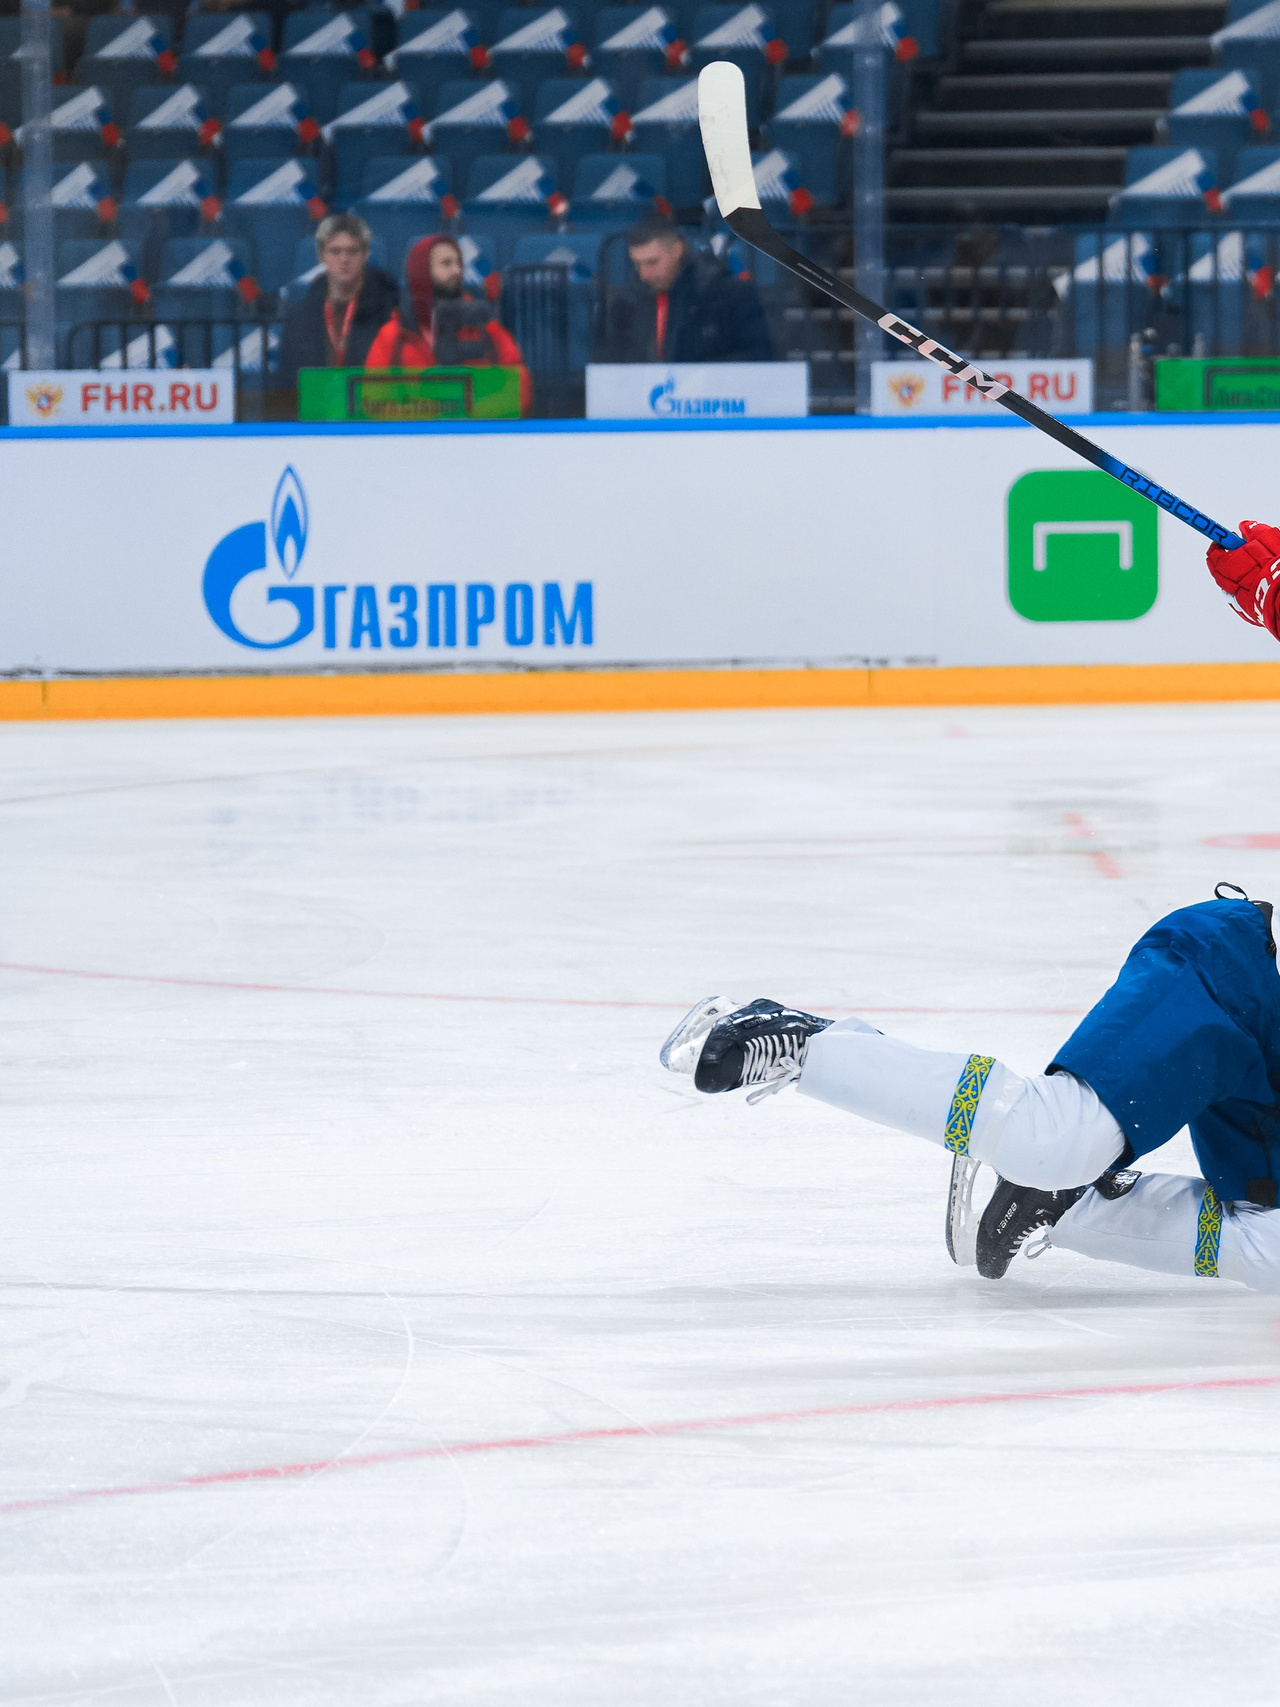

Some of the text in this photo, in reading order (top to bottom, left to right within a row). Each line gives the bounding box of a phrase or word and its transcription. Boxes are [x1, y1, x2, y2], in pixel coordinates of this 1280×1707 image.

[877, 313, 1010, 400] CCM
[81, 383, 219, 412] FHR.RU
[1120, 466, 1229, 543] RIBCOR
[323, 582, 594, 649] ГАЗПРОМ
